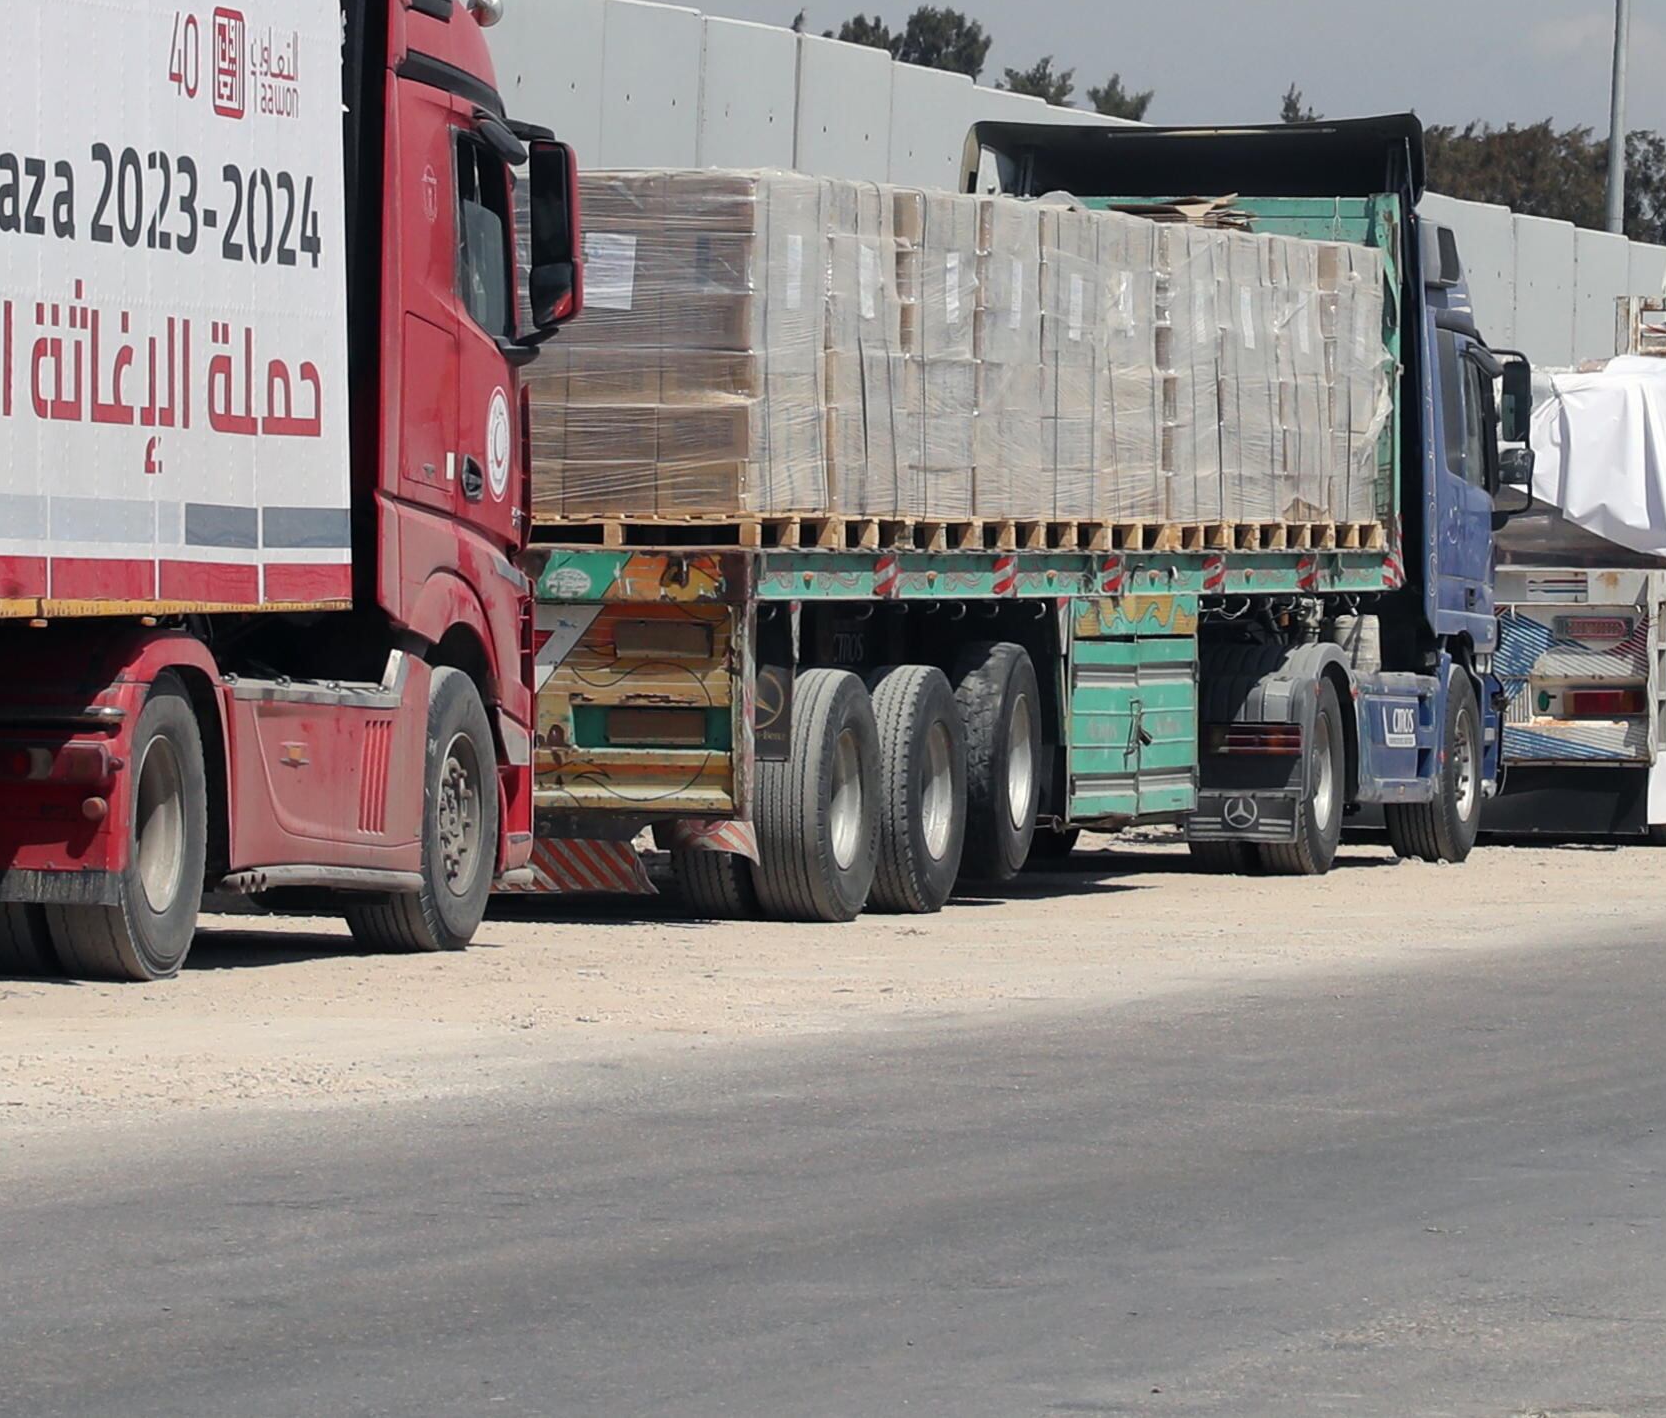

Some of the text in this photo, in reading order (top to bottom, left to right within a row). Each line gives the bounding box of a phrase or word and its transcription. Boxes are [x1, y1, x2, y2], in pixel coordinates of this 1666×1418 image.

[169, 10, 200, 99] 40
[90, 142, 321, 269] 2023-2024
[31, 278, 191, 474] الإغاثة
[208, 322, 322, 438] حملة
